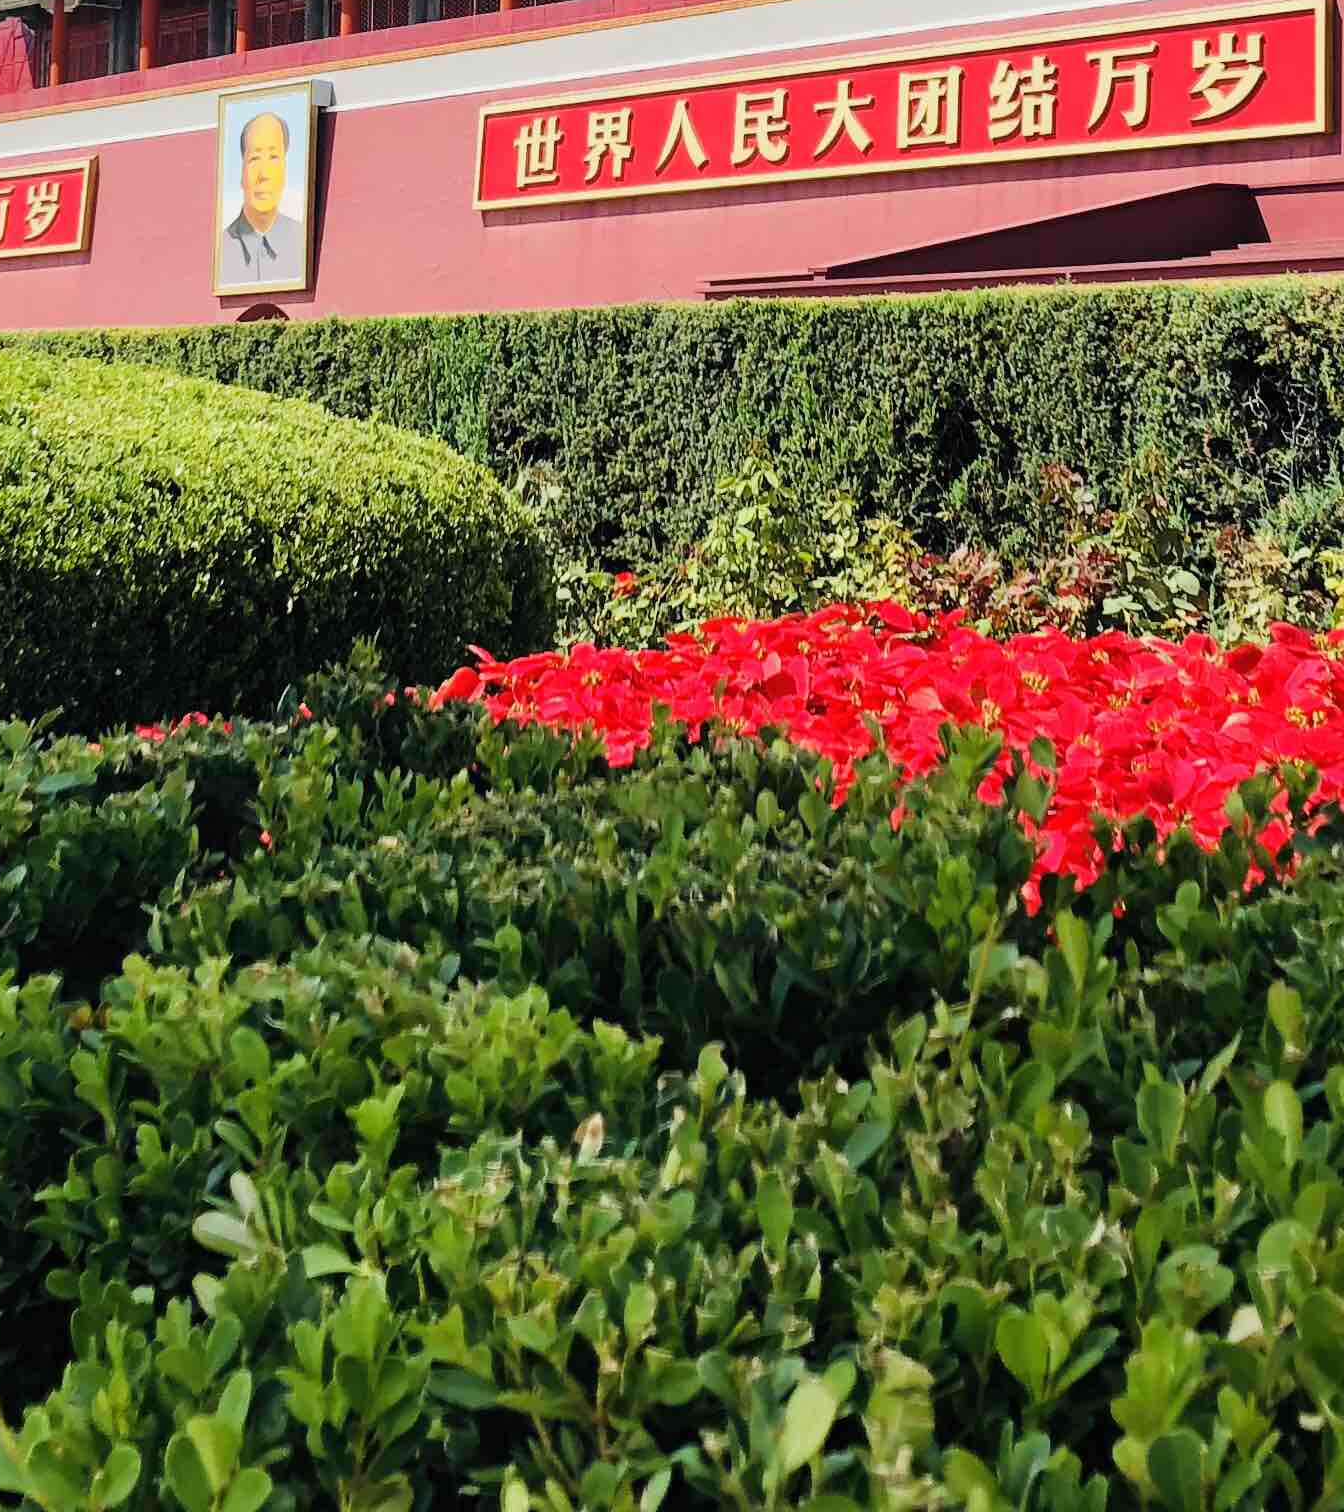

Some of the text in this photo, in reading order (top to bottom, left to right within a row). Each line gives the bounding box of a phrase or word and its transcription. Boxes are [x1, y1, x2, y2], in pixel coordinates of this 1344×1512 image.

[513, 32, 1267, 189] 世界人民大团结万岁
